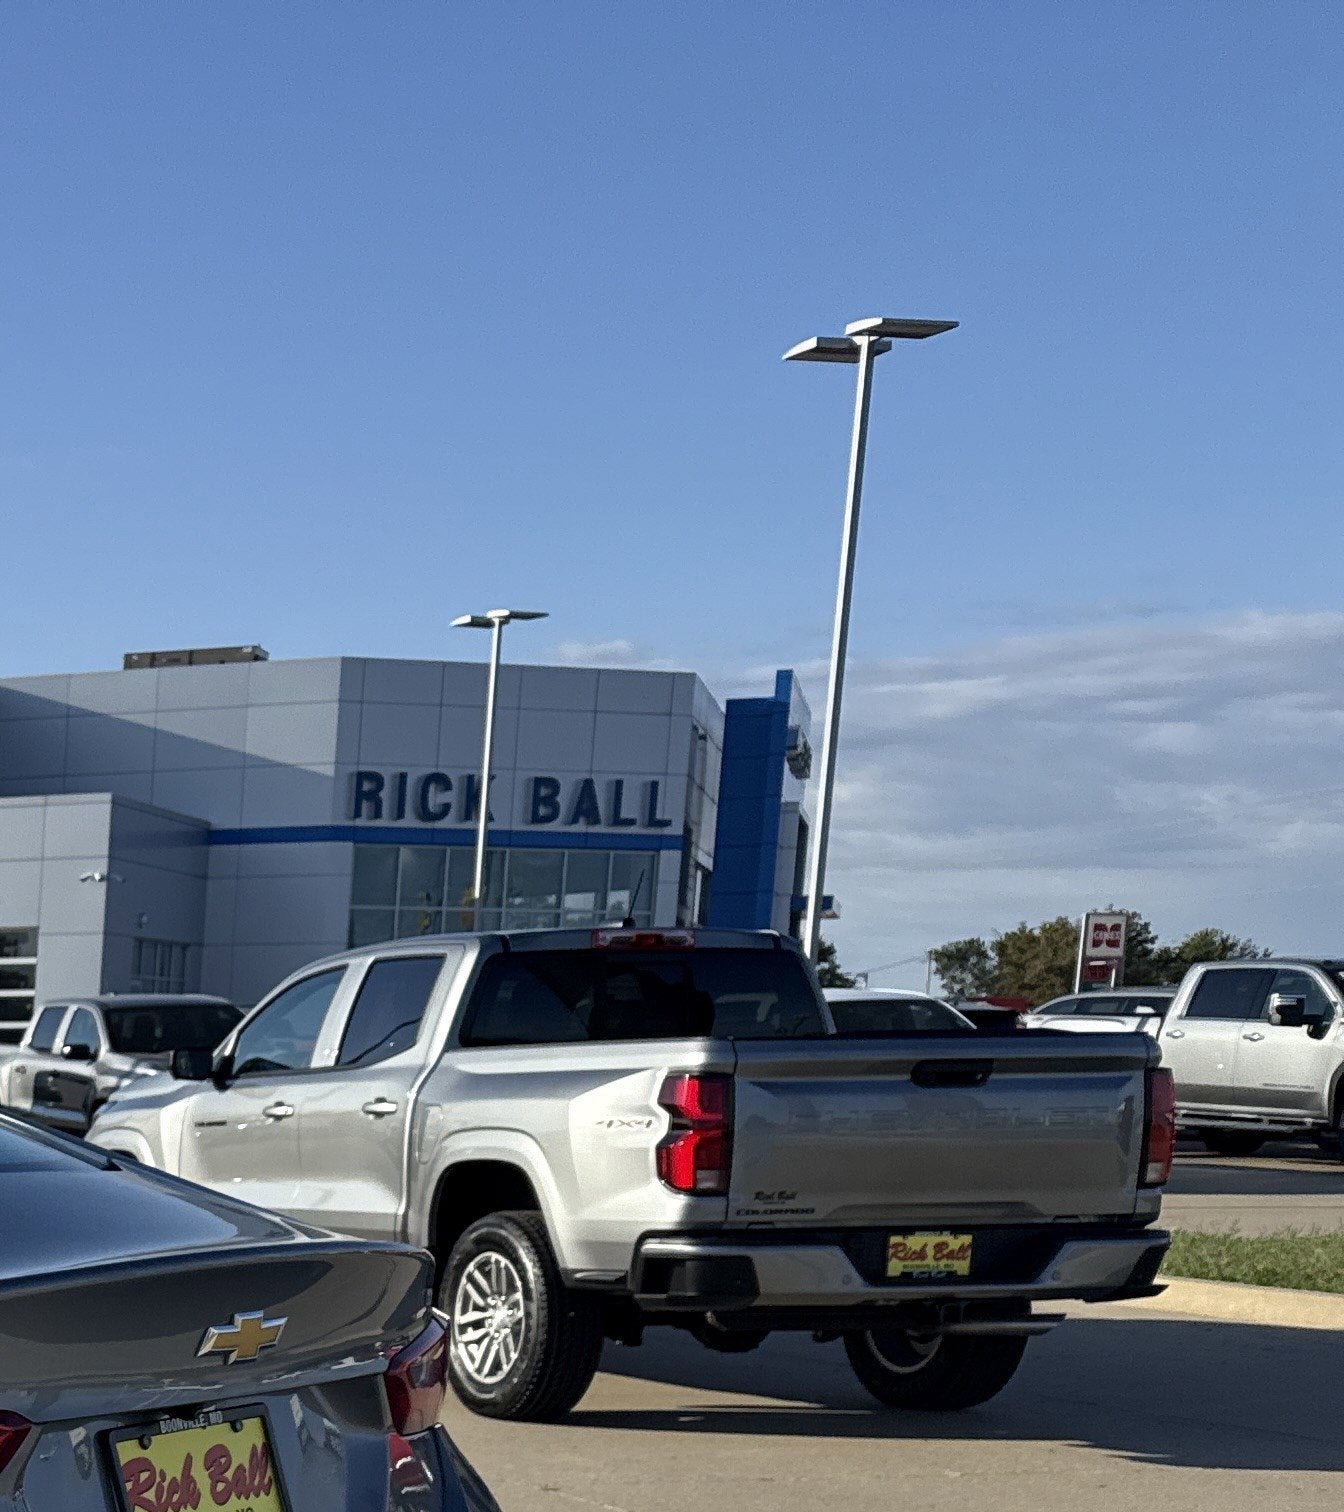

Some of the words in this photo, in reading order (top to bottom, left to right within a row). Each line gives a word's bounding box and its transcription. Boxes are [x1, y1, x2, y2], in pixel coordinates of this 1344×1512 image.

[352, 770, 495, 823] RICK
[529, 775, 673, 828] BALL
[203, 1441, 273, 1506] Ball
